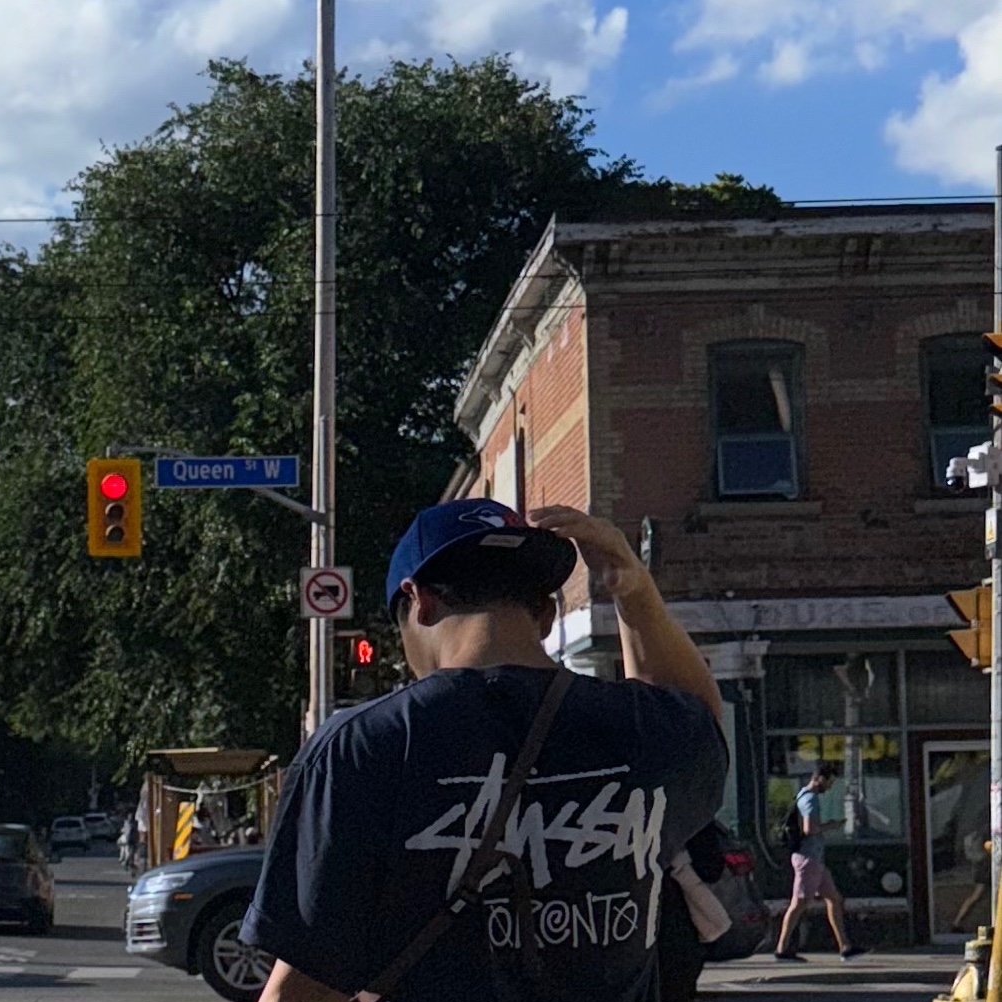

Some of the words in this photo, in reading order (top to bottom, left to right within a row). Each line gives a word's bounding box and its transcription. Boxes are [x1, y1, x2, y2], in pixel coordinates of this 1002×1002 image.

[173, 460, 235, 481] Queen
[245, 459, 257, 471] St
[263, 459, 281, 479] W
